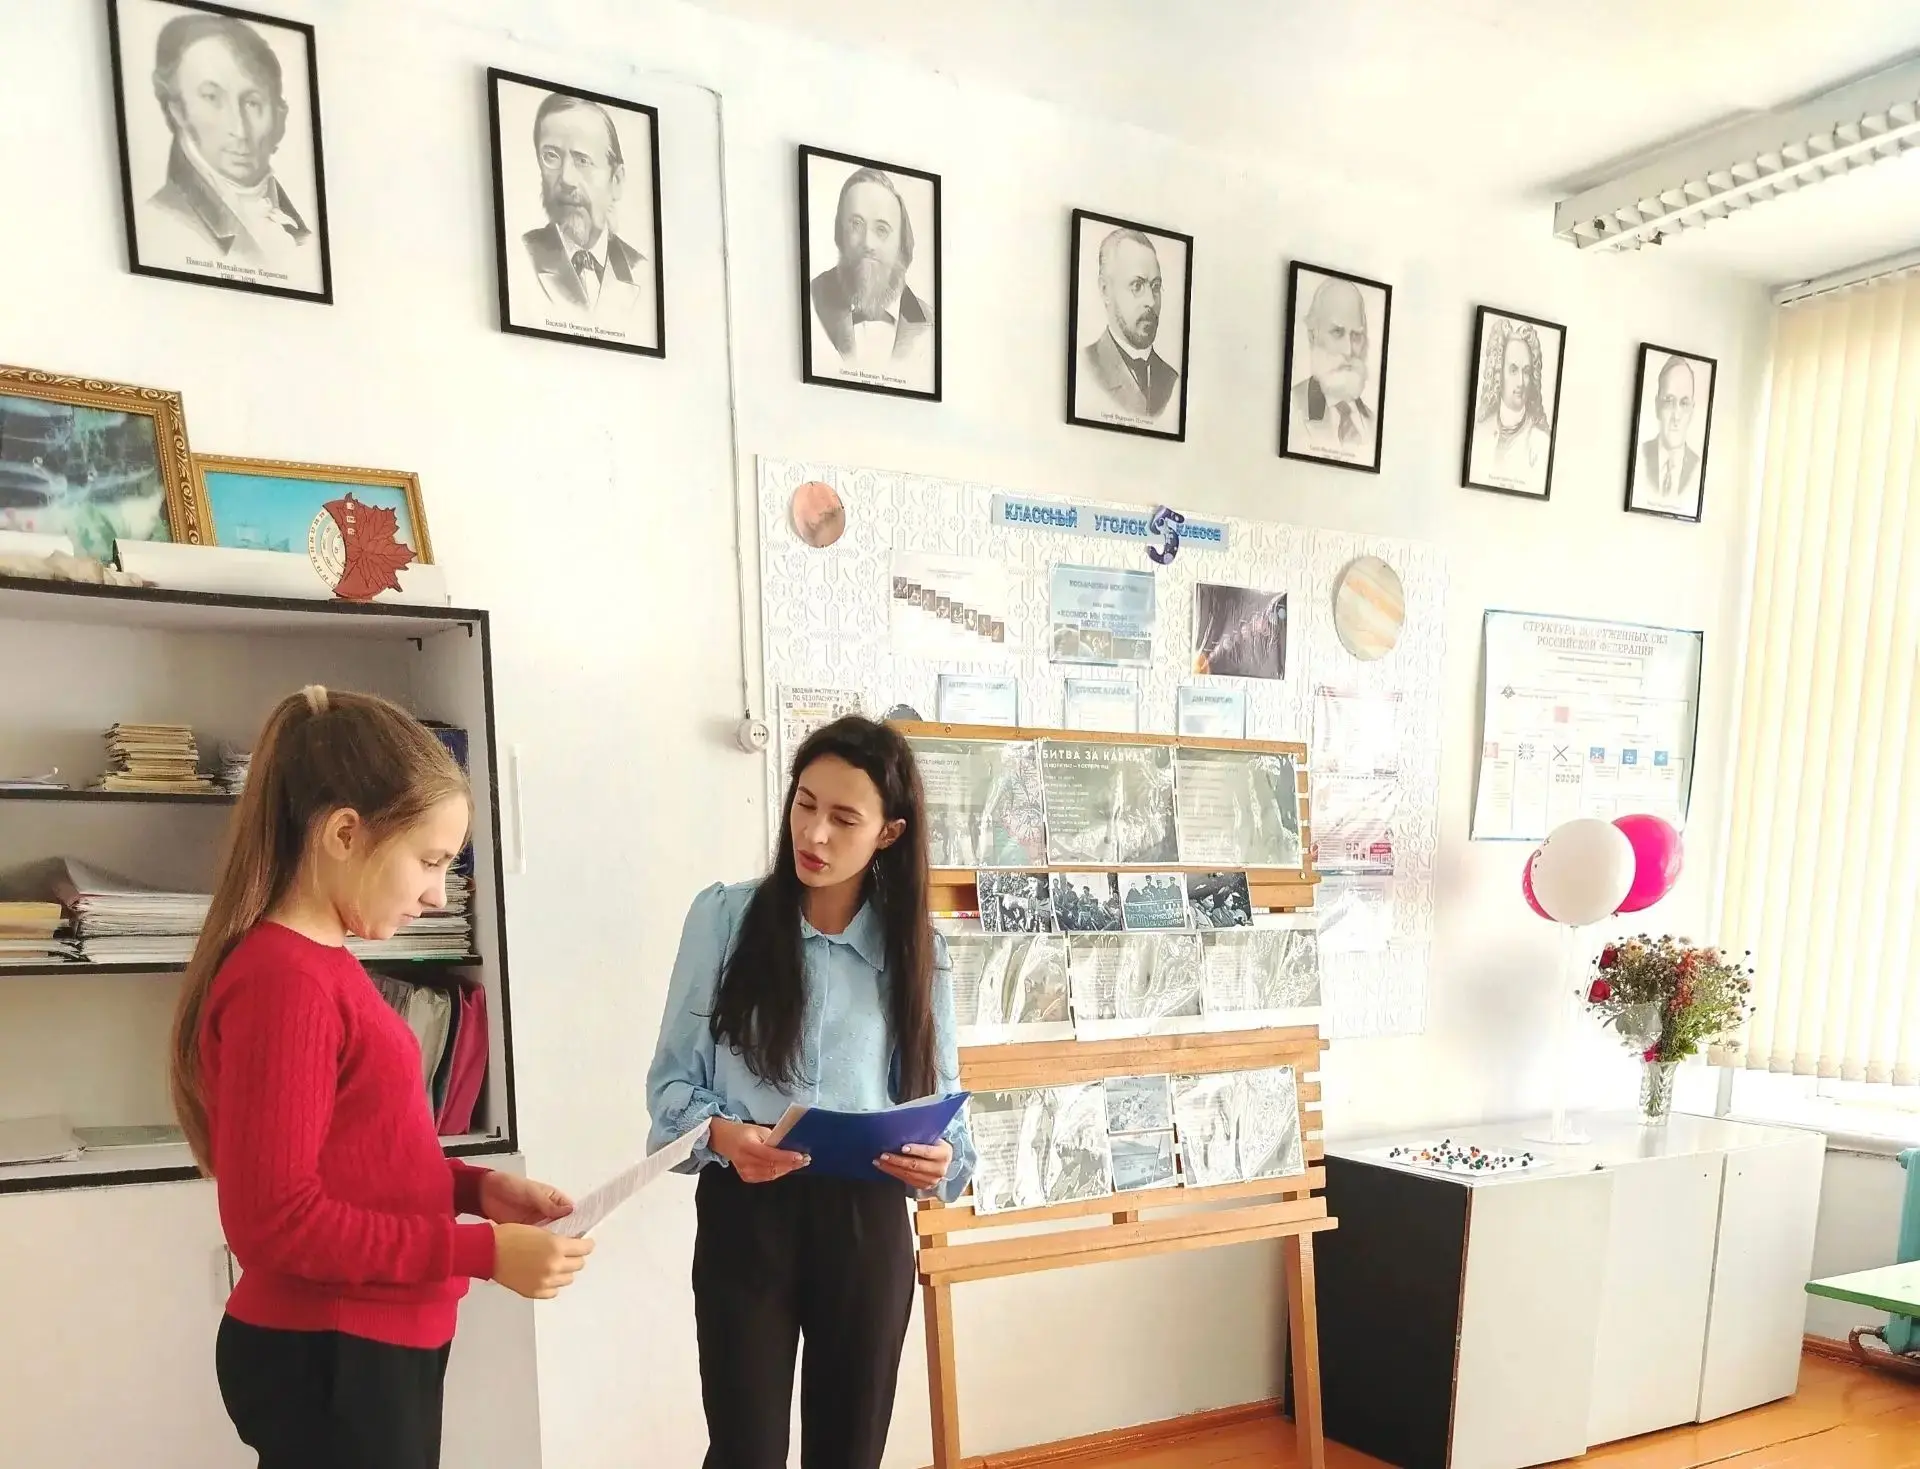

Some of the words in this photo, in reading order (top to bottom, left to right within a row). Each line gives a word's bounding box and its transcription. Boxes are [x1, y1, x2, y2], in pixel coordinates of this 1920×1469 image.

[1004, 502, 1078, 528] КЛАССНЫЙ
[1093, 514, 1149, 537] УГОЛОК
[1145, 505, 1185, 565] 5
[1523, 620, 1576, 636] СТРУКТУРА
[1651, 633, 1669, 645] СИЛ
[1537, 635, 1597, 651] РОССИЙСКОЙ
[1042, 750, 1081, 760] БИТВА
[1085, 751, 1099, 760] ЗА
